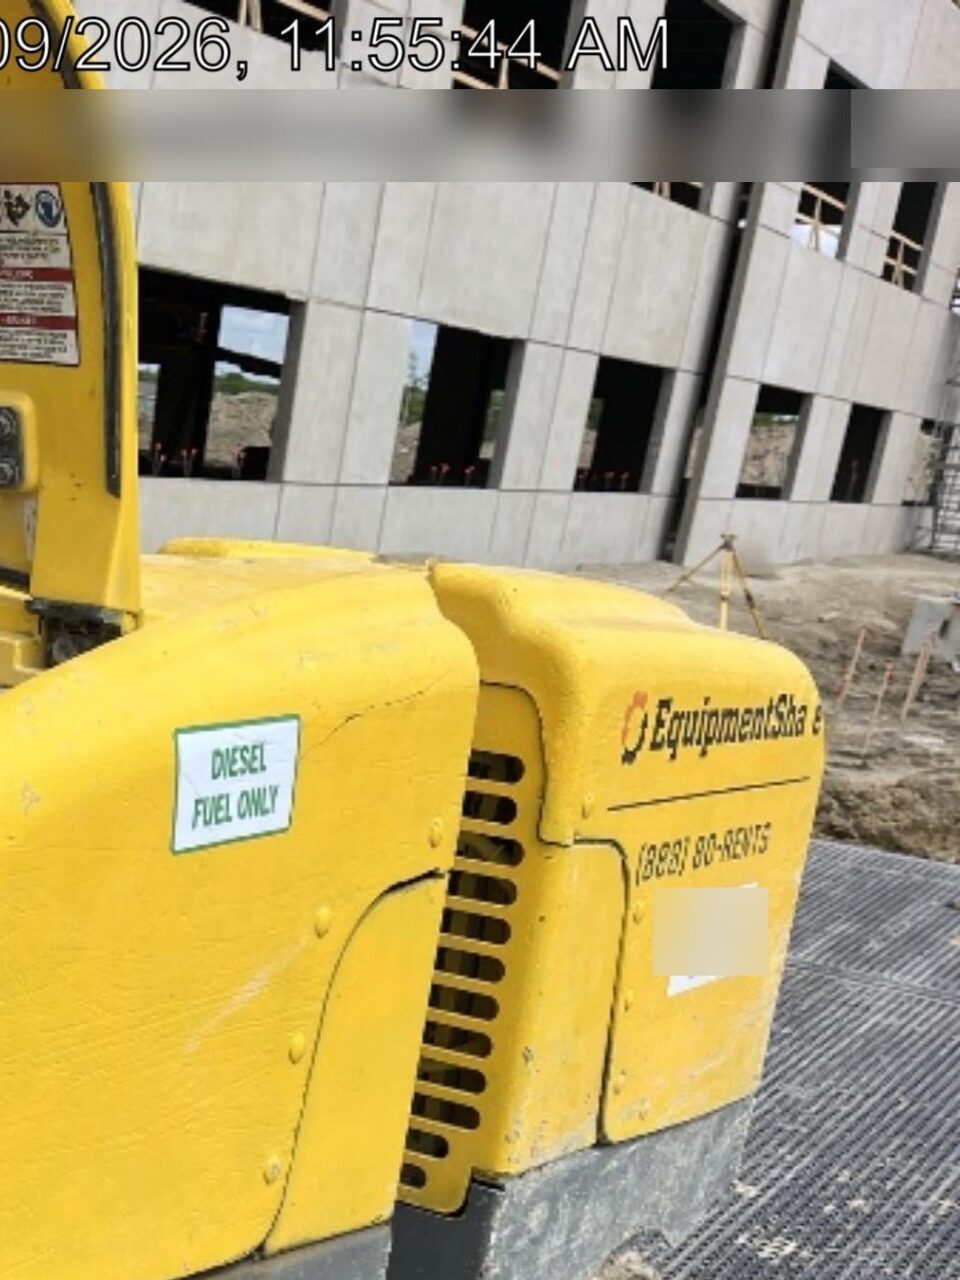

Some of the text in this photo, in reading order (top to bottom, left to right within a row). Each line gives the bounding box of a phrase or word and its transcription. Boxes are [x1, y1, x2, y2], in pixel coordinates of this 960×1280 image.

[649, 694, 822, 761] EquipmentShae
[211, 740, 267, 780] DIESEL
[192, 785, 279, 830] FUEL ONLY
